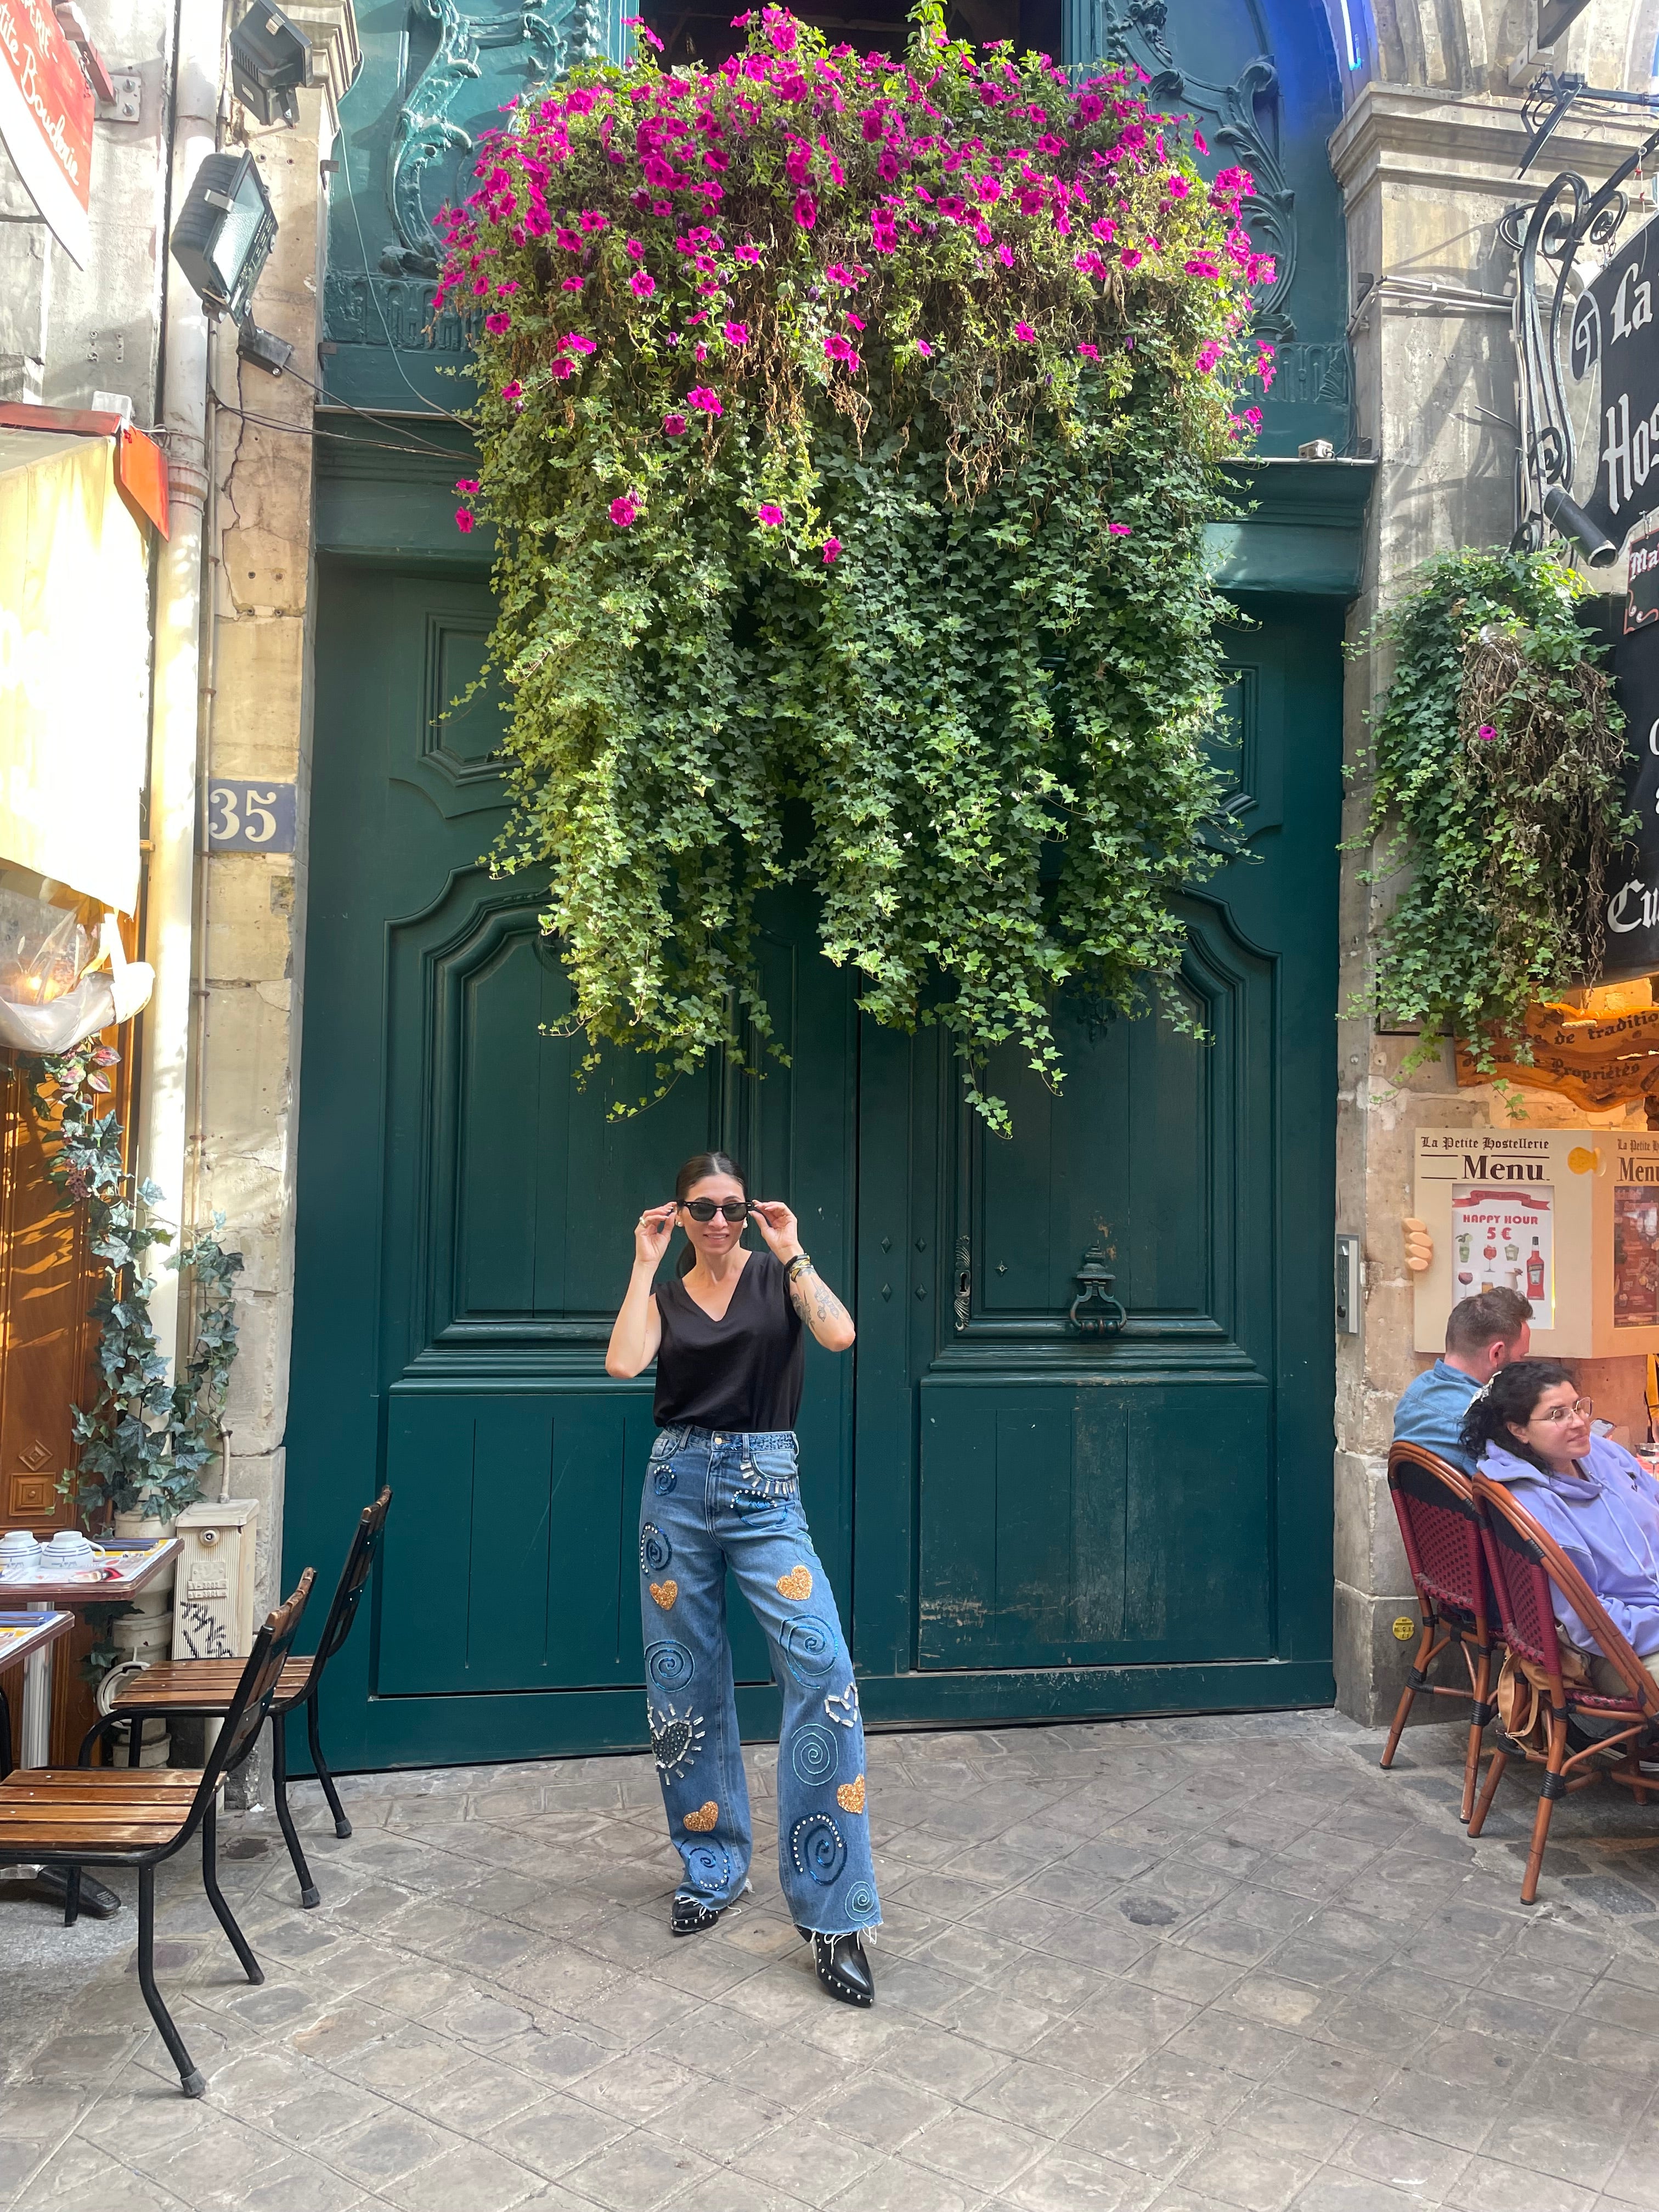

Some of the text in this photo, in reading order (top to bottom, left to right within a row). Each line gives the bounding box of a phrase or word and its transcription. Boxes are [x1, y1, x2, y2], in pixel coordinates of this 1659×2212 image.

[1610, 263, 1653, 345] La
[208, 788, 276, 842] 35
[1554, 1030, 1576, 1045] de
[1421, 1137, 1549, 1150] La Petite Hostellerie
[1617, 1138, 1627, 1150] La
[1462, 1155, 1546, 1181] Menu
[1463, 1215, 1538, 1224] HAPPY HOUR
[1487, 1227, 1512, 1240] 5 €
